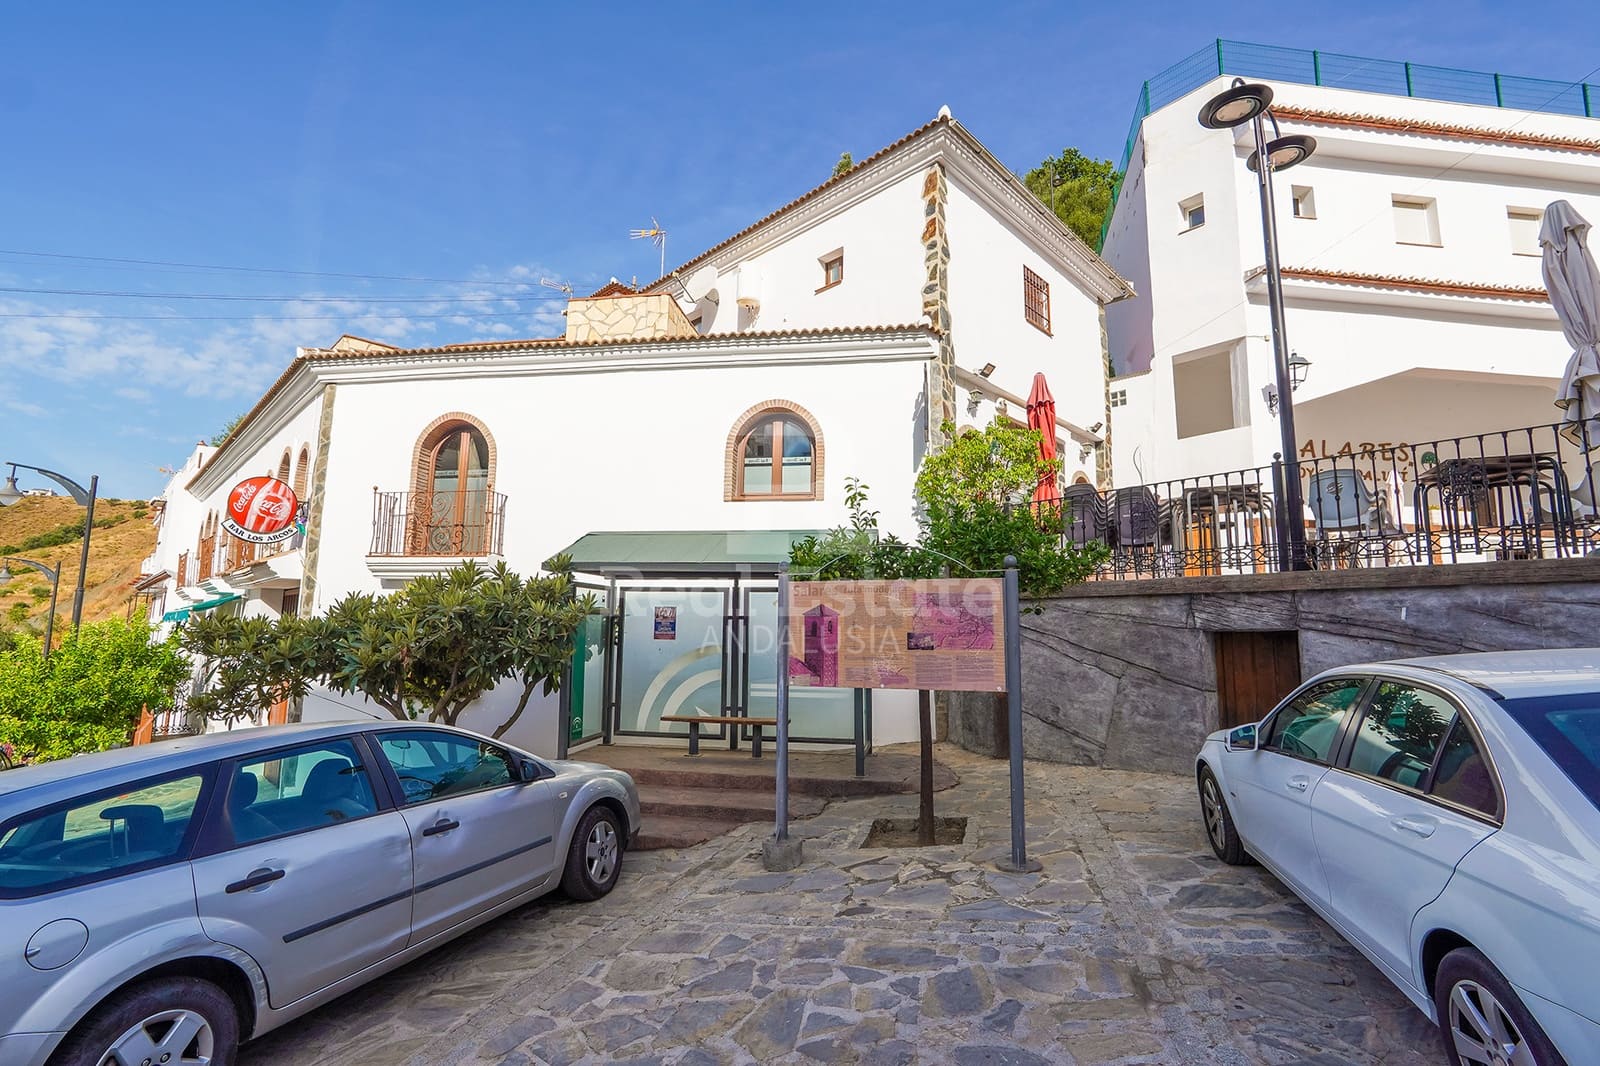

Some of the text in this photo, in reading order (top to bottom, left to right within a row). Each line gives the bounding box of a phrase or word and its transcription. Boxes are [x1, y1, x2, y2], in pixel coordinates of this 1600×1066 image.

[1299, 439, 1410, 462] ALARES
[228, 523, 245, 537] BAR
[267, 527, 294, 541] ARCOS
